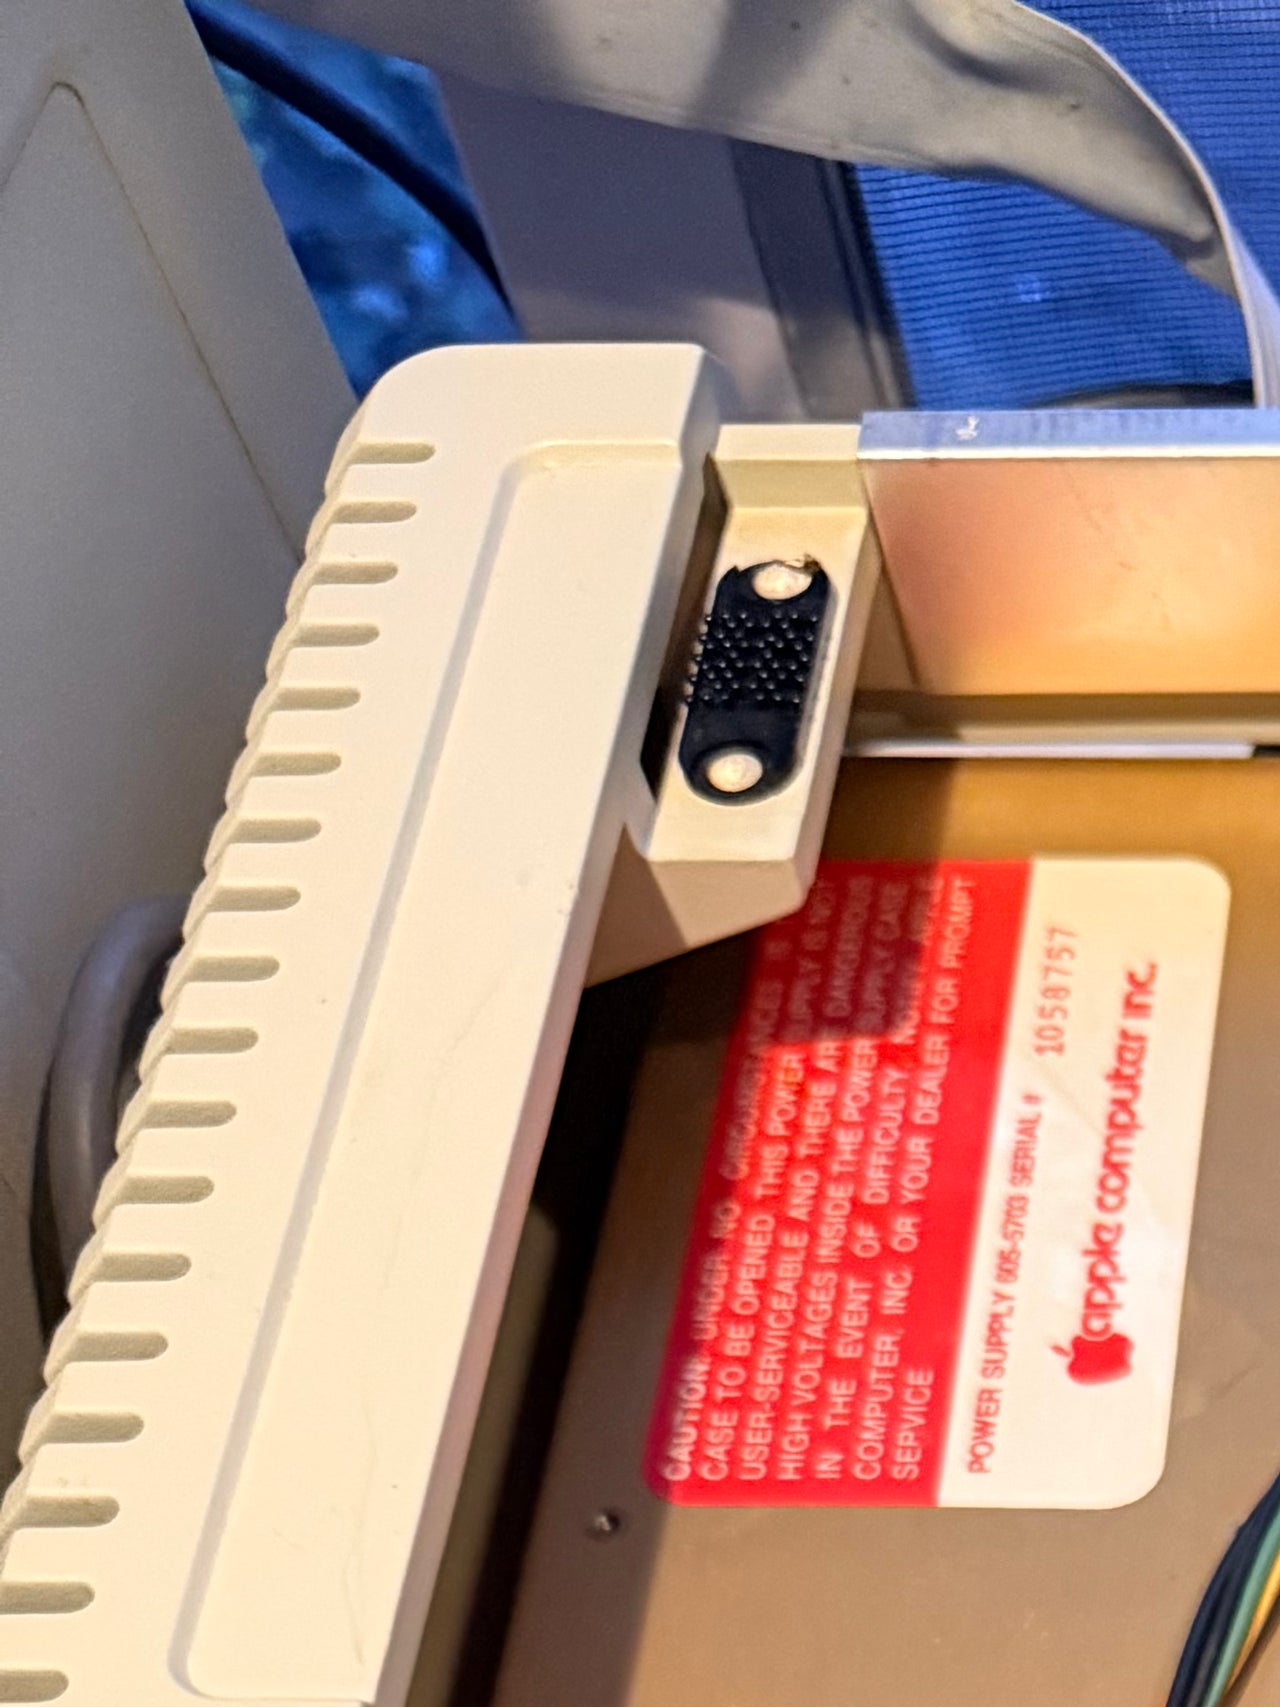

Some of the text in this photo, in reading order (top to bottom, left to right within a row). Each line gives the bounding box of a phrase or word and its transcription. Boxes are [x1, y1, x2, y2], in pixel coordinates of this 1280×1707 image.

[938, 873, 972, 968] PROMPT
[929, 974, 958, 1024] FOR
[1034, 925, 1076, 1056] 1058757
[764, 1049, 803, 1136] POWER
[795, 1079, 836, 1158] THERE
[841, 1035, 877, 1121] POWER
[913, 1032, 949, 1124] DEALER
[829, 1127, 863, 1175] THE
[1009, 1111, 1042, 1187] SERIAL
[1096, 1028, 1146, 1213] computer
[749, 1143, 788, 1200] THIS
[786, 1167, 819, 1221] AND
[900, 1134, 932, 1203] YOUR
[816, 1182, 853, 1263] INSIDE
[890, 1213, 920, 1252] OR
[814, 1067, 905, 1479] IN THE EVENT OF DIFFICULTY
[1075, 1221, 1124, 1342] apple
[721, 1322, 754, 1356] BE
[741, 1232, 806, 1479] USER-SERVICEABLE
[791, 1270, 837, 1404] VOLTAGES
[980, 1290, 1014, 1379] SUPPLY
[713, 1363, 746, 1400] TO
[698, 1410, 737, 1481] CASE
[777, 1411, 810, 1480] HIGH
[891, 1368, 932, 1479] SERVICE
[967, 1387, 1001, 1474] POWER
